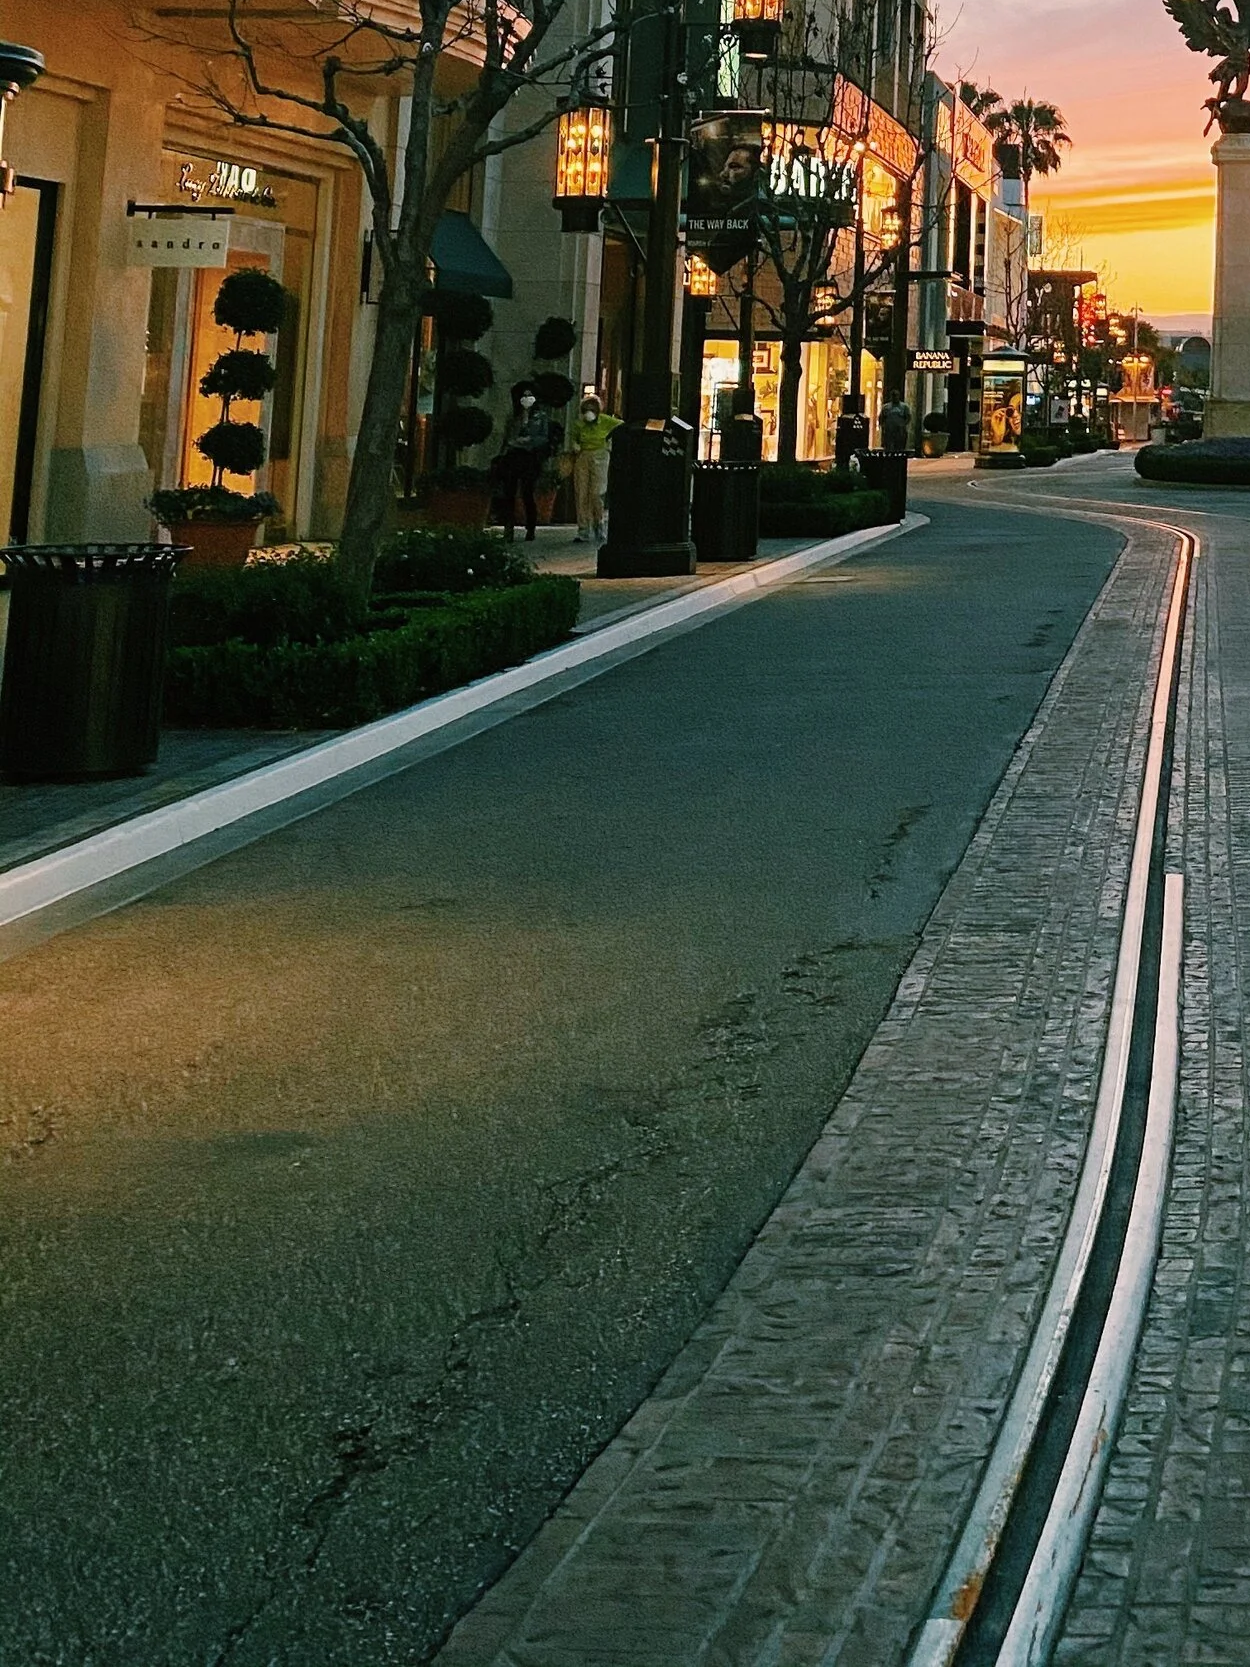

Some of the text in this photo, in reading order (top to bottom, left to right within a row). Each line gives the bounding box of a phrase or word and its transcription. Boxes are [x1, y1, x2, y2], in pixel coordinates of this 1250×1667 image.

[688, 218, 749, 230] THE WAY BACK
[136, 238, 220, 250] sandro
[915, 351, 950, 360] BANANA
[913, 360, 952, 370] REPUBLIC
